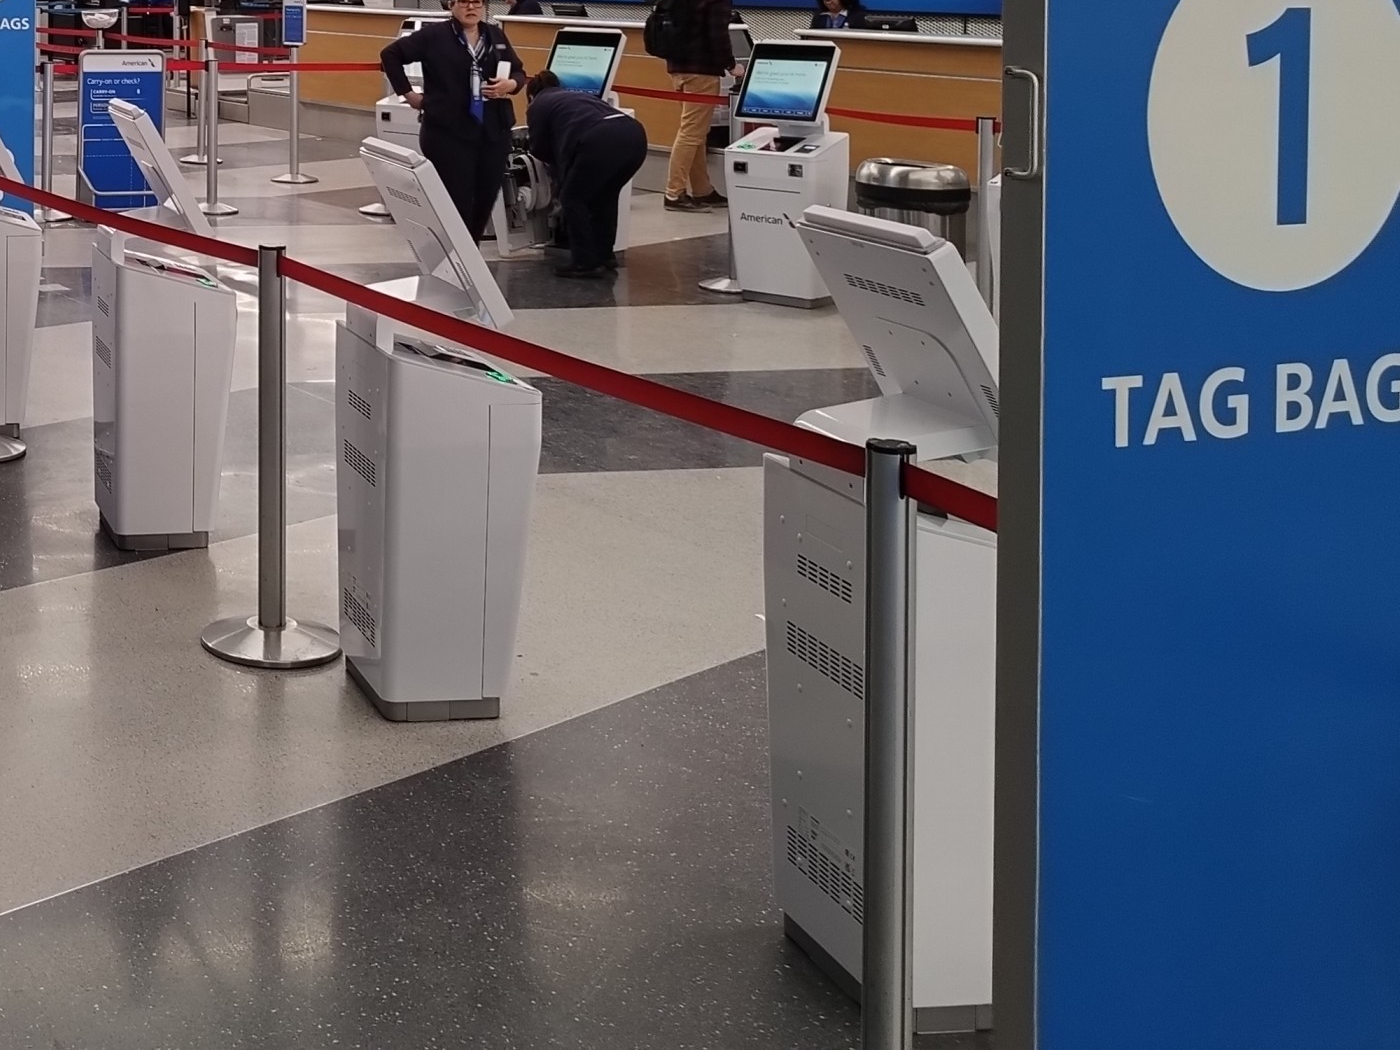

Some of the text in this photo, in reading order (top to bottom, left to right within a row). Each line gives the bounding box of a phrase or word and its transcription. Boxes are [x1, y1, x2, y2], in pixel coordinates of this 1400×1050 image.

[87, 78, 113, 86] Carry-on
[1245, 7, 1312, 227] 1
[740, 212, 783, 225] American
[1101, 352, 1400, 448] TAG BAG
